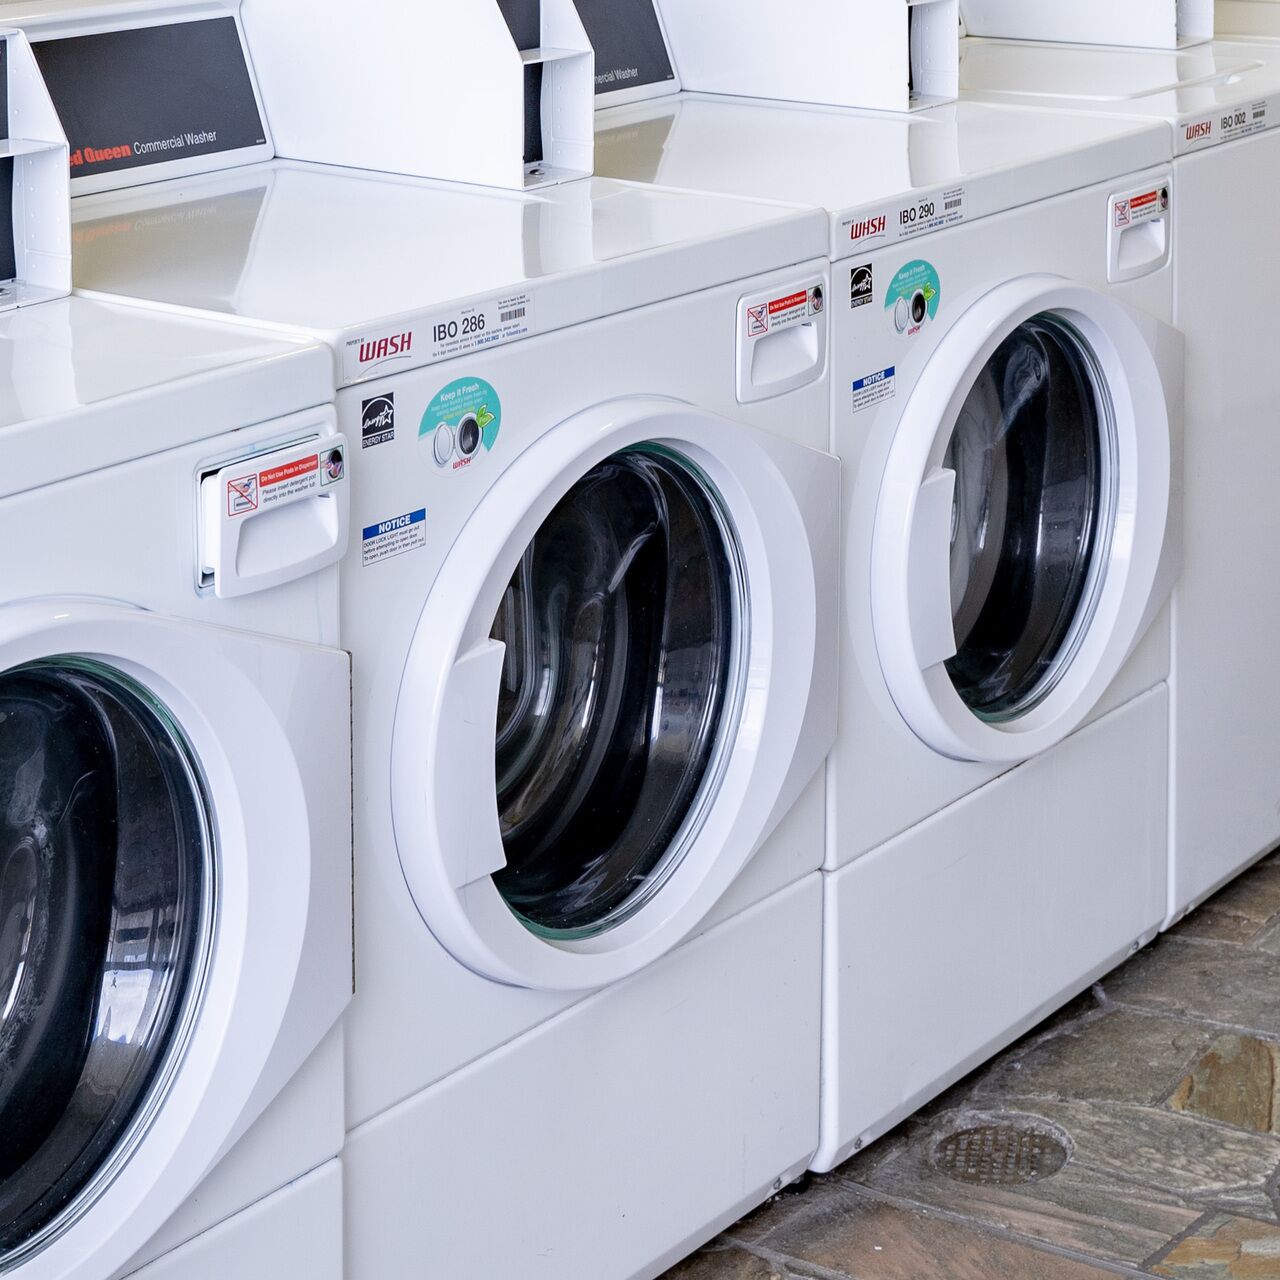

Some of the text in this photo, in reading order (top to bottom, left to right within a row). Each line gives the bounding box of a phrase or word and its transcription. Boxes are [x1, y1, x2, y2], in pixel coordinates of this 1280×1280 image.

[614, 66, 638, 81] Washer
[1221, 112, 1246, 129] IBO 002
[1186, 121, 1211, 140] WASH
[84, 139, 132, 165] Queen
[134, 133, 184, 156] Commercial
[184, 128, 216, 147] Washer
[900, 202, 934, 224] IBO 290
[851, 216, 885, 240] WASH
[434, 313, 484, 342] IBO 286
[360, 332, 412, 363] WASH
[863, 371, 884, 386] NOTICE
[363, 430, 394, 448] ENERGY STAR
[379, 515, 411, 534] NOTICE
